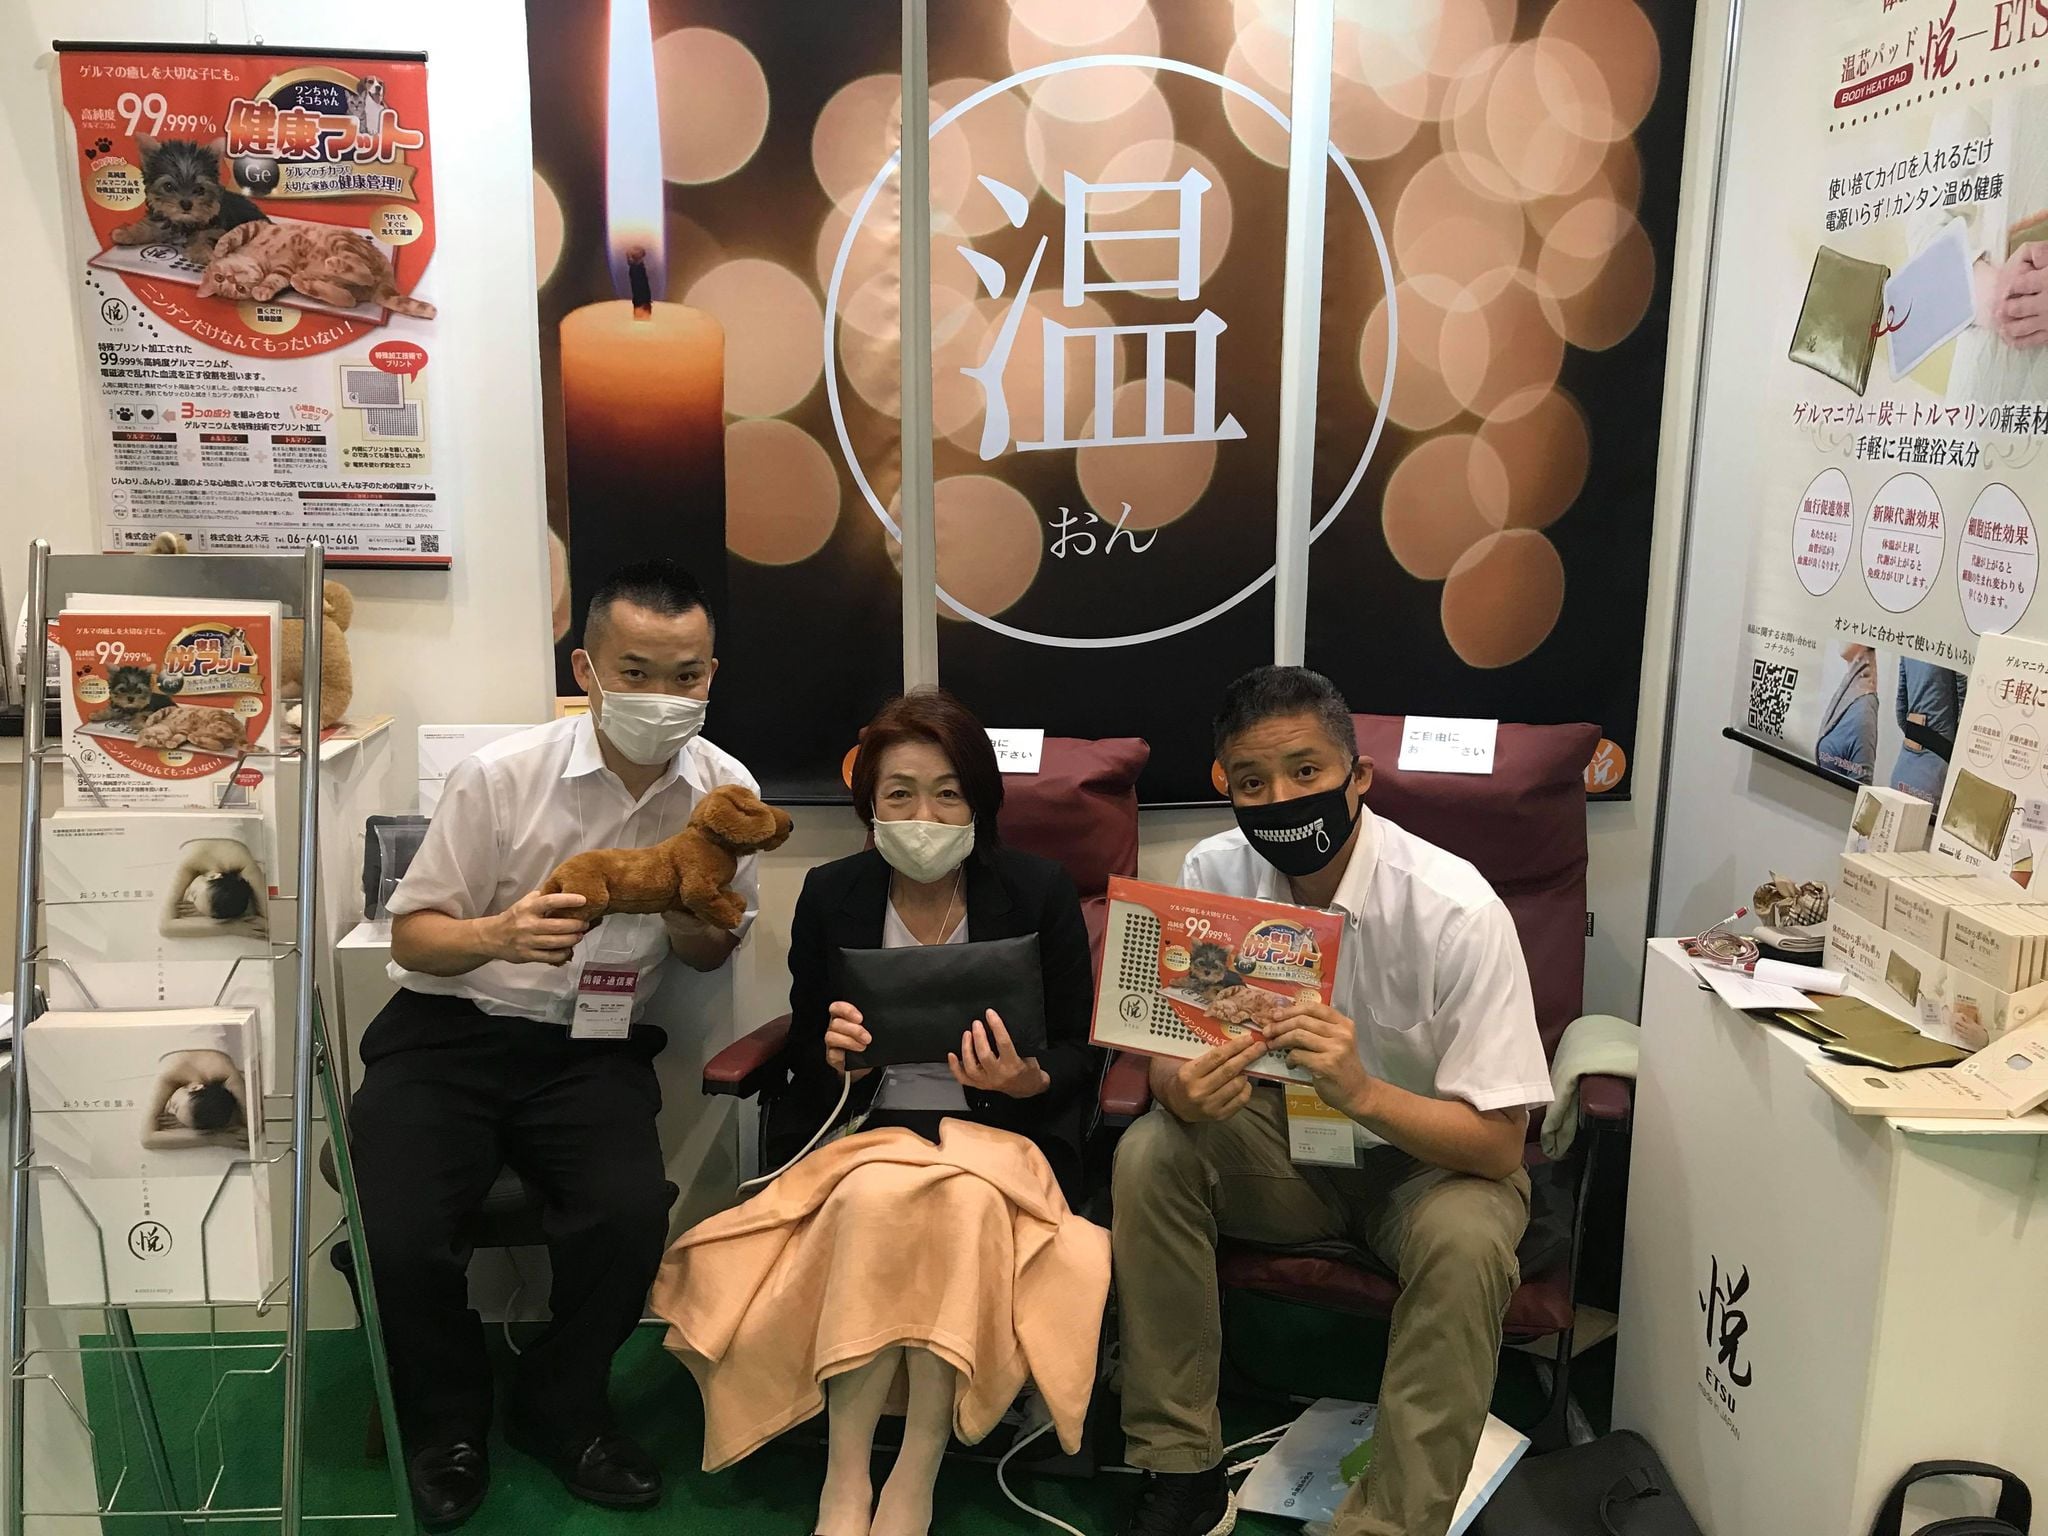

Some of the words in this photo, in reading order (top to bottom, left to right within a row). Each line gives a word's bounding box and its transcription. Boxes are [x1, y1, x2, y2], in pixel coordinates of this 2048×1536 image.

[1841, 26, 1919, 83] 温芯パッド
[79, 65, 241, 82] ゲルマの癒しを大切な子にも。
[295, 85, 339, 97] ワンちゃん
[1841, 88, 1864, 103] BODY
[1866, 80, 1887, 94] HEAT
[1888, 70, 1907, 87] PAD
[295, 96, 340, 107] ネコちゃん
[81, 108, 116, 121] 高純度
[117, 92, 217, 137] 99.999%
[225, 99, 424, 164] 健康マット
[244, 166, 272, 184] Ge
[1828, 138, 1994, 201] 使い捨てカイロを入れるだけ
[283, 175, 403, 193] 大切な家族の健康管理！
[1825, 173, 2005, 232] 電源いらず！カンタン温め健康
[383, 213, 409, 221] 汚れても
[140, 283, 354, 352] ニンゲンだけなんてもったいない！
[956, 166, 1248, 461] 温
[98, 343, 193, 354] 特殊プリント加工された
[99, 352, 233, 369] 99.999%高純度ゲルマニウムが、
[386, 360, 413, 368] プリント
[100, 368, 266, 381] 電磁波で乱れた血流を正す役割を担います。
[1855, 435, 1980, 468] 手軽に岩盤浴気分
[1803, 497, 1850, 518] 血行促進効果
[1872, 504, 1940, 530] 新陳代謝効果
[210, 533, 242, 542] 株式会社
[245, 533, 270, 542] 久木元
[1048, 501, 1158, 559] おん
[1810, 528, 1837, 543] あたためると
[1967, 516, 2029, 546] 細胞活性効果
[1882, 538, 1921, 555] 体温が上昇し
[1876, 553, 1922, 571] 代謝が上がると
[1867, 567, 1929, 590] 免疫力がUPします。
[1763, 642, 1795, 657] コチラから
[2000, 678, 2047, 708] 手軽に
[1409, 731, 1460, 743] ご自由に
[1698, 1254, 1753, 1387] 悦
[1705, 1366, 1736, 1414] ETSU
